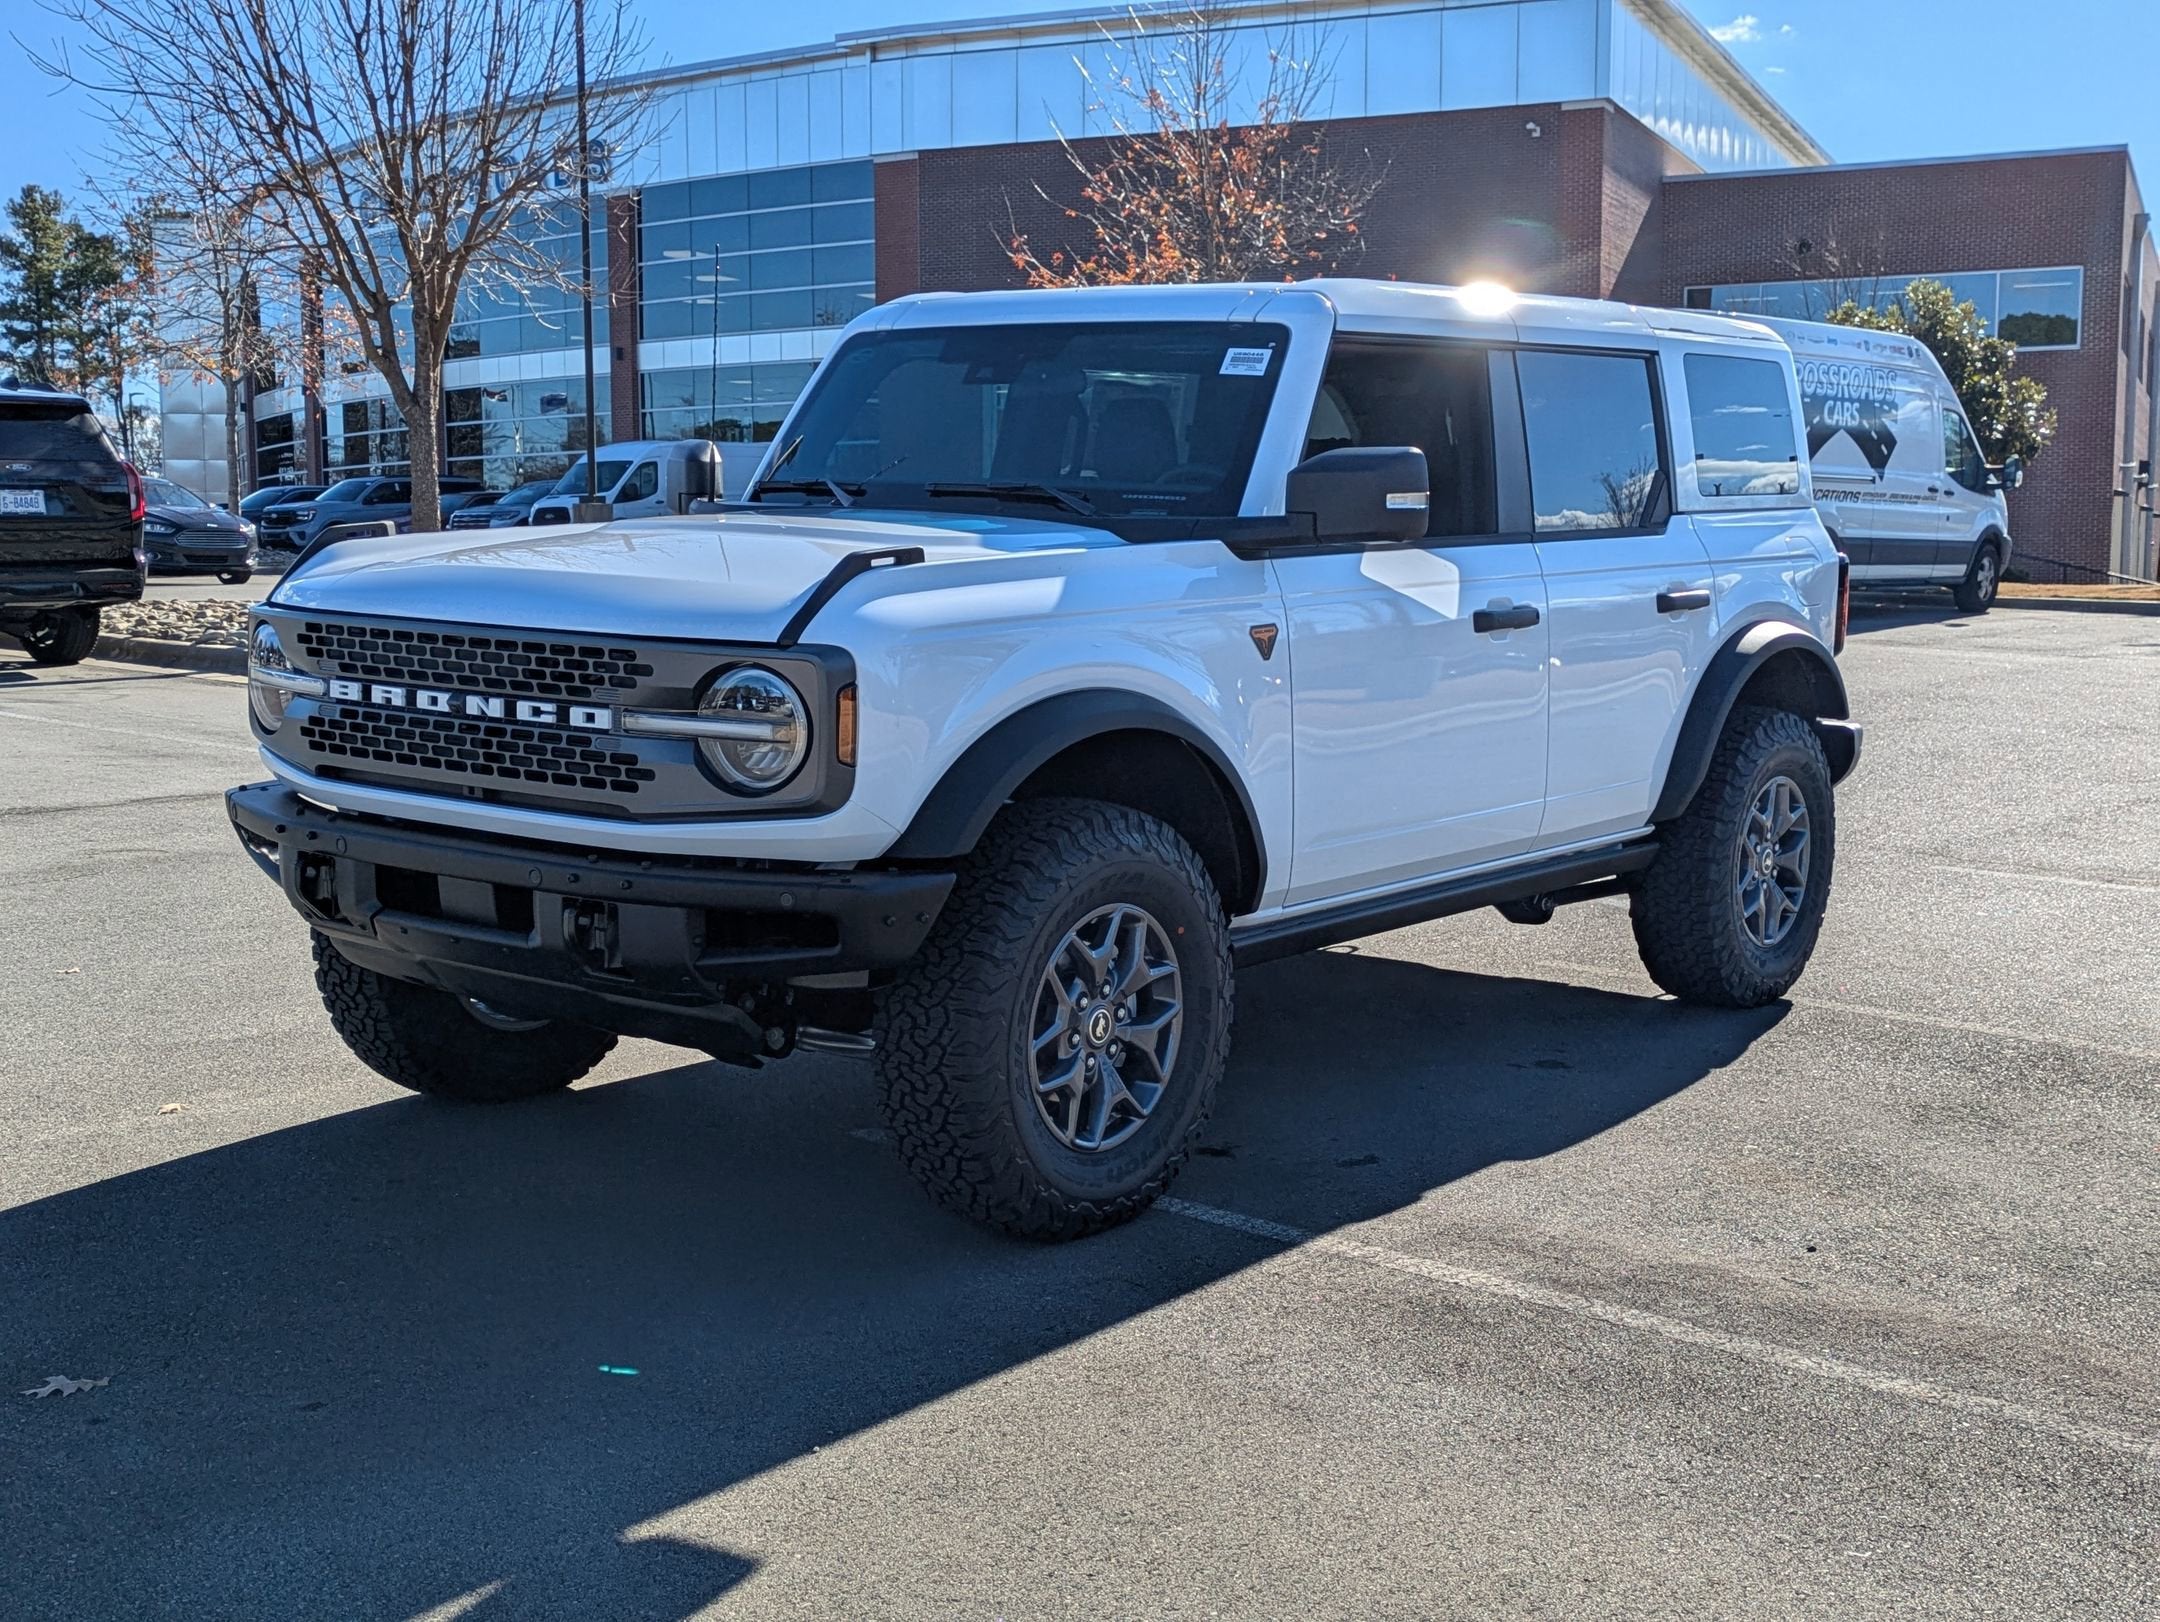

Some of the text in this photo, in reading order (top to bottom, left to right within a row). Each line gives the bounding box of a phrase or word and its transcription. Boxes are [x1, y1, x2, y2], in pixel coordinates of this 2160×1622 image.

[1796, 361, 1897, 402] ROSSROADS
[1824, 400, 1860, 426] CARS
[1813, 488, 1861, 504] CATIONS
[329, 679, 613, 730] BRONCO
